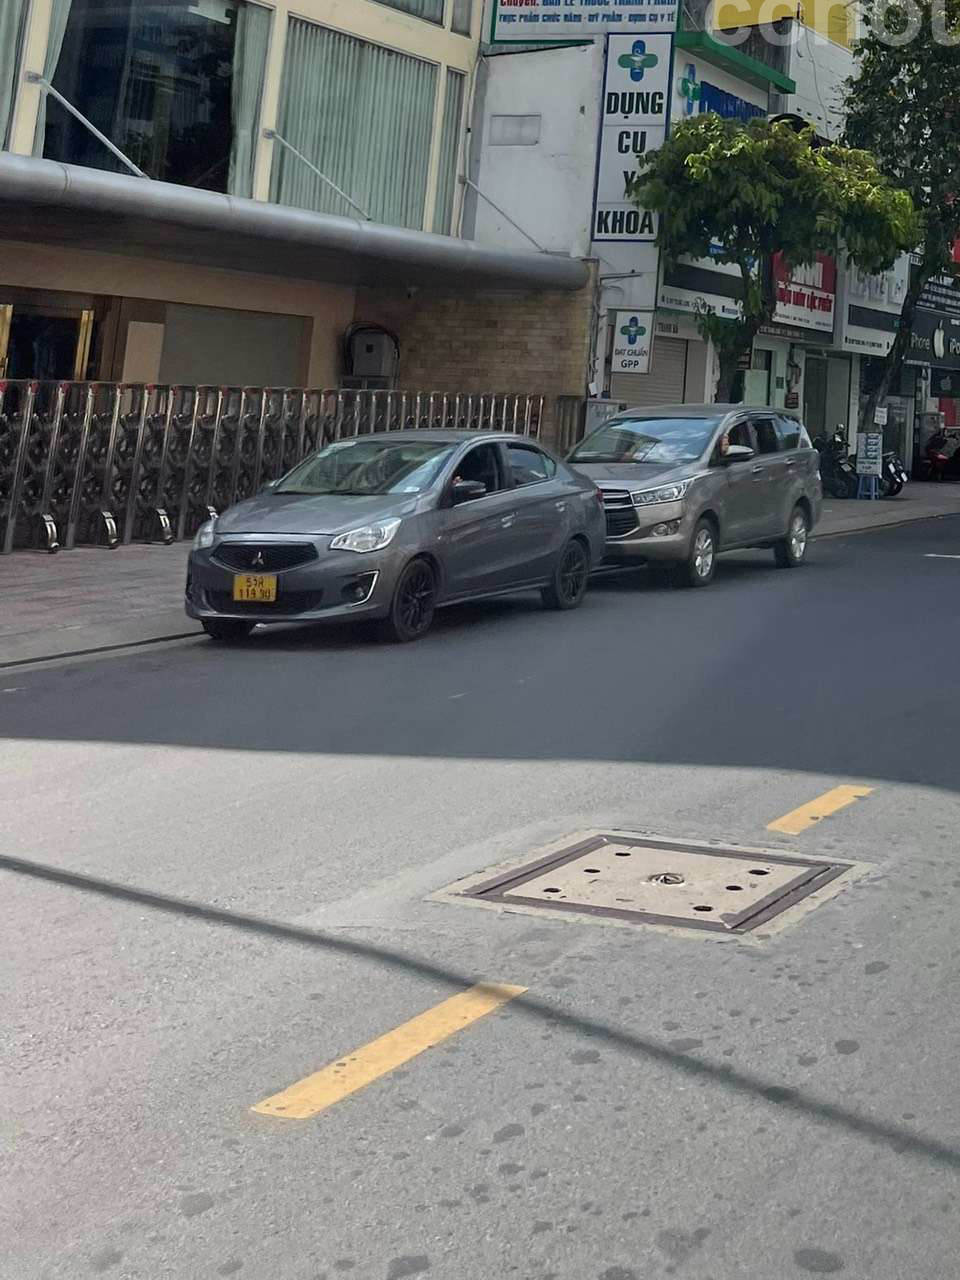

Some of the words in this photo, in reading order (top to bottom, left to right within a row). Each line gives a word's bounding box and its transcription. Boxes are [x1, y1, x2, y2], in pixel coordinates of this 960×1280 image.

[606, 91, 664, 119] DỤNG
[618, 130, 647, 158] CỤ
[596, 210, 655, 234] KHOA
[620, 359, 640, 368] GPP
